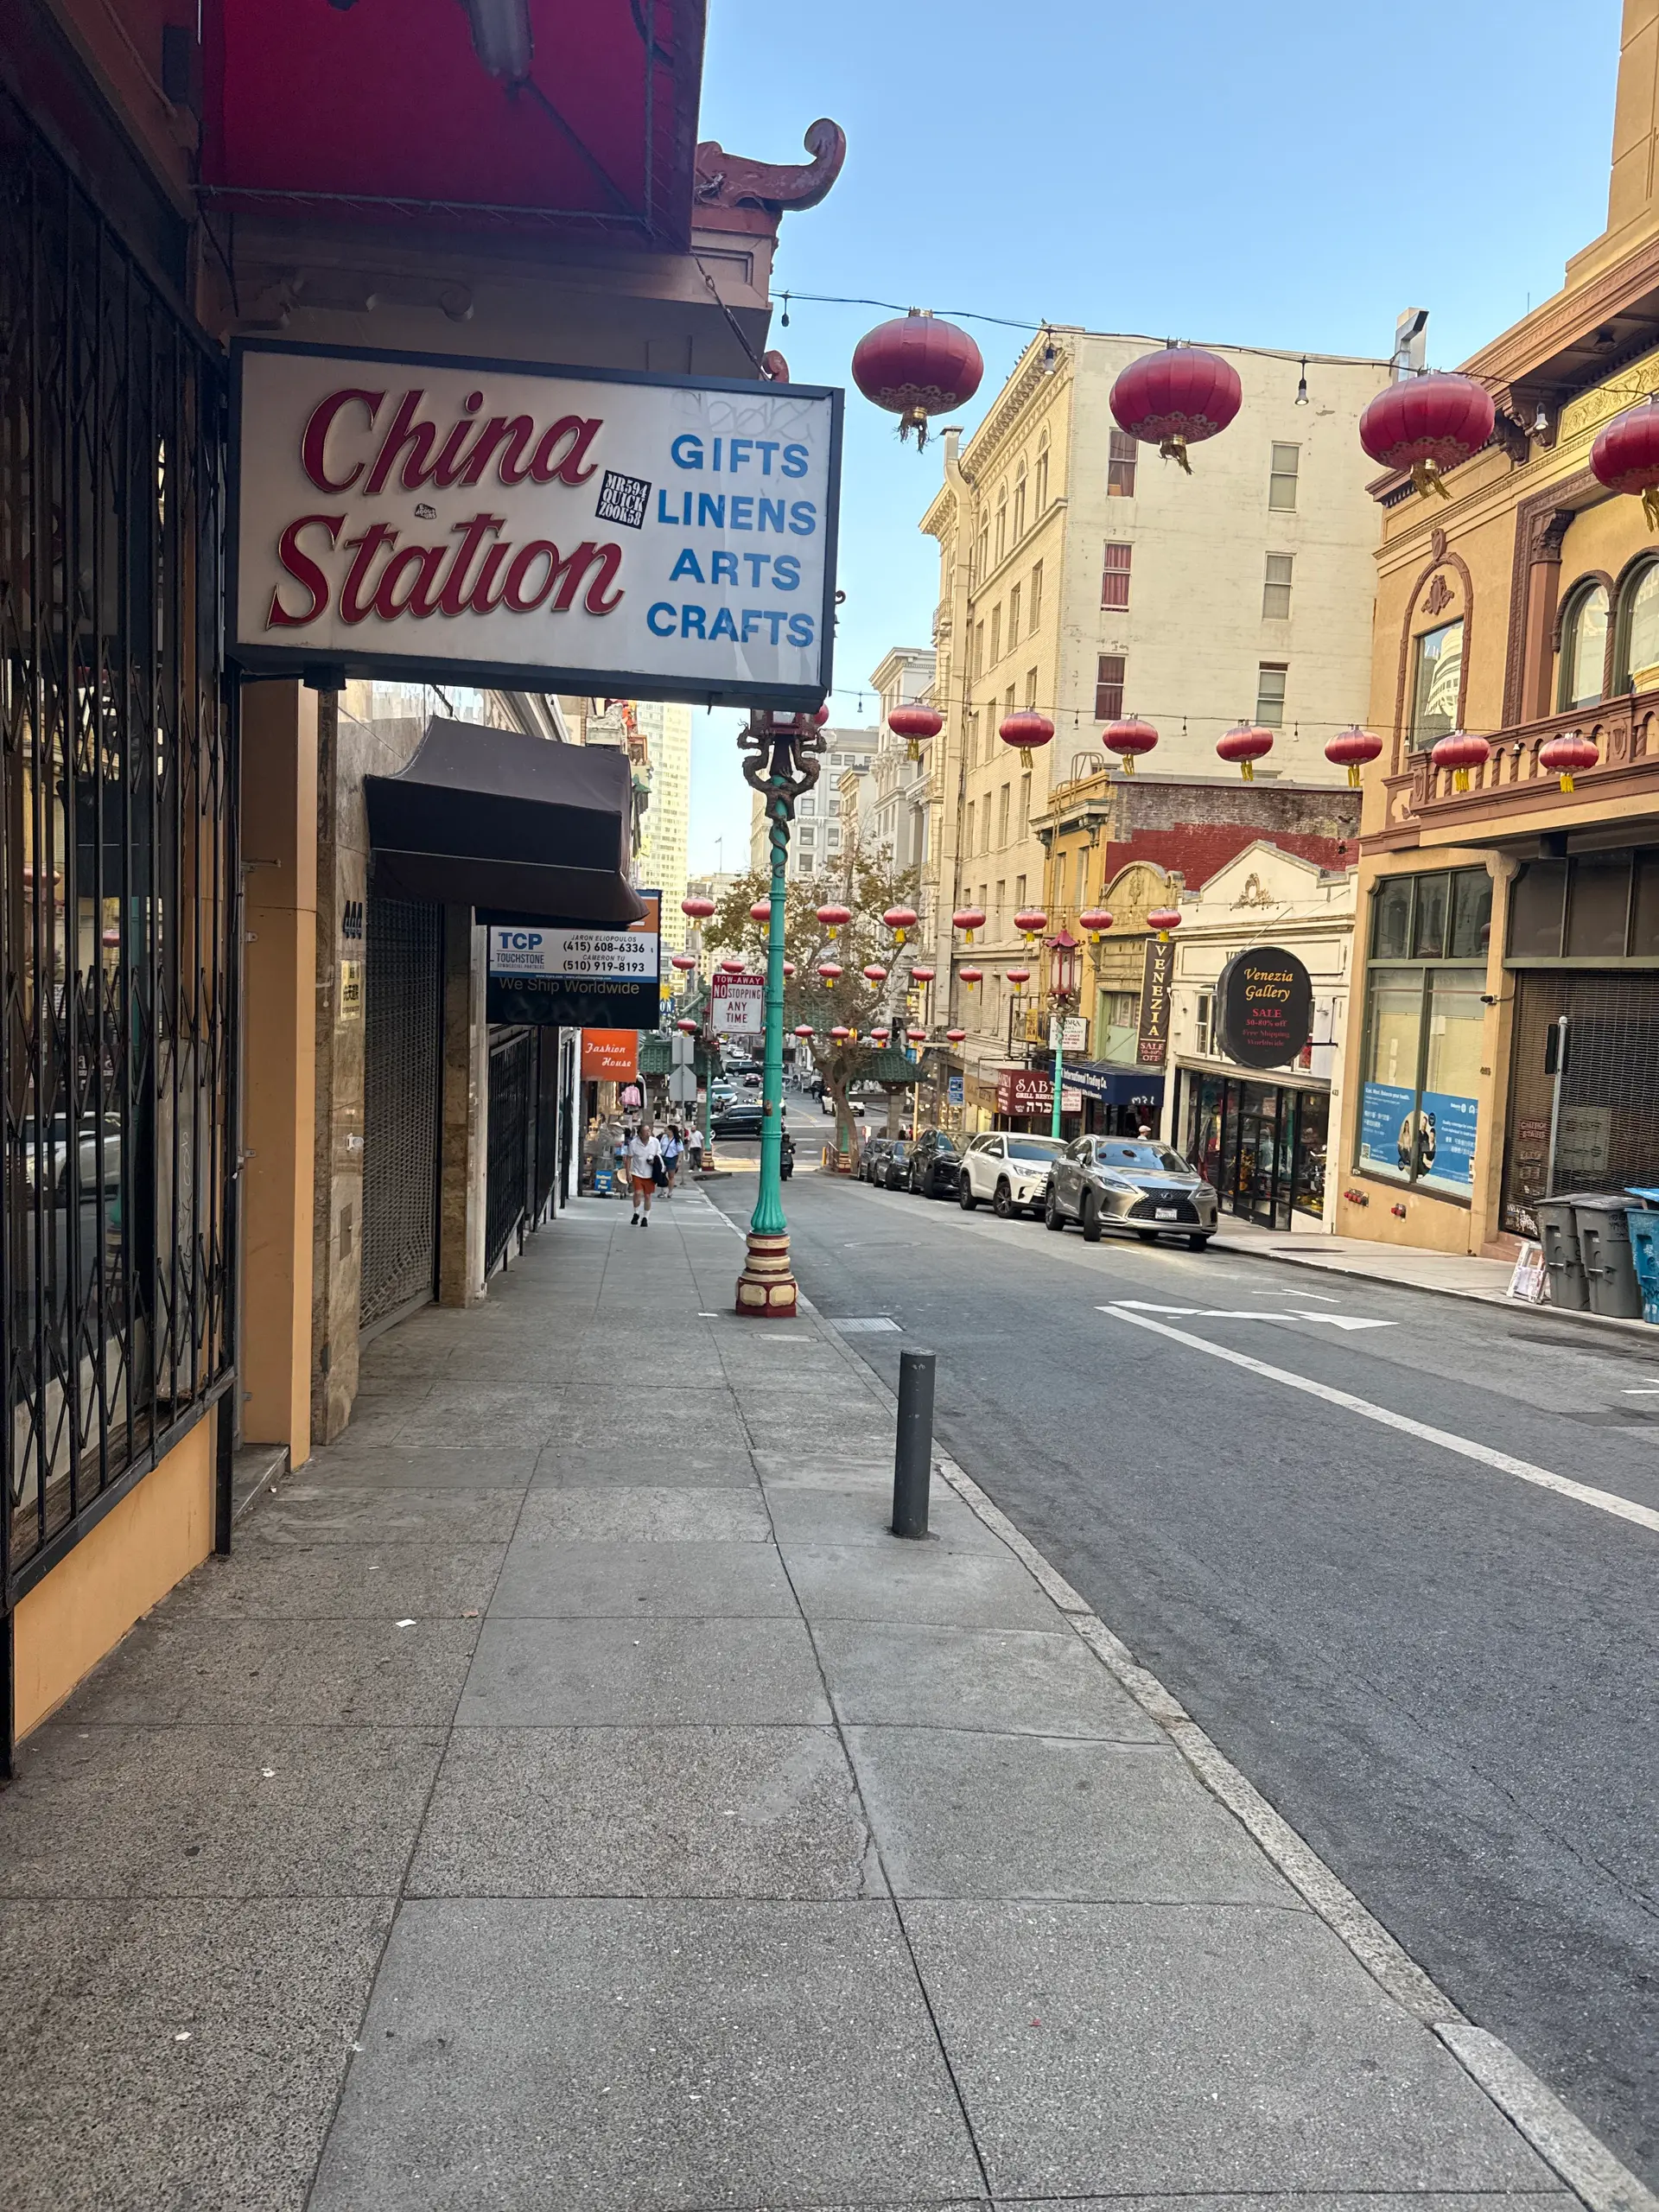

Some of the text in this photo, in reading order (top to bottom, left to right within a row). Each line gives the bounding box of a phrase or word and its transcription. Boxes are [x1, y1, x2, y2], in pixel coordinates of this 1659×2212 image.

[302, 390, 603, 495] China
[671, 434, 810, 478] GIFTS
[606, 474, 647, 498] MR594
[602, 487, 645, 512] QUICK
[599, 501, 641, 525] ZOOK58
[658, 489, 817, 536] LINENS
[266, 513, 625, 631] Station
[669, 548, 801, 591] ARTS
[646, 602, 815, 647] CRAFTS
[499, 932, 543, 950] TCP
[563, 941, 645, 953] (415) 608-6336
[497, 953, 544, 964] TOUCHSTONE
[563, 960, 645, 972] (510) 919-8193
[1243, 968, 1294, 982] Venezia
[499, 977, 639, 995] We Ship Worldwide
[714, 984, 760, 999] NO STOPPING
[1148, 945, 1167, 1036] VENEZIA
[1245, 985, 1291, 1002] Gallery
[728, 1001, 747, 1011] ANY
[1253, 1008, 1282, 1017] SALE
[727, 1013, 747, 1023] TIME
[585, 1043, 626, 1053] Fashion
[602, 1058, 632, 1067] House
[1064, 1068, 1086, 1084] International
[1087, 1073, 1100, 1090] Trading
